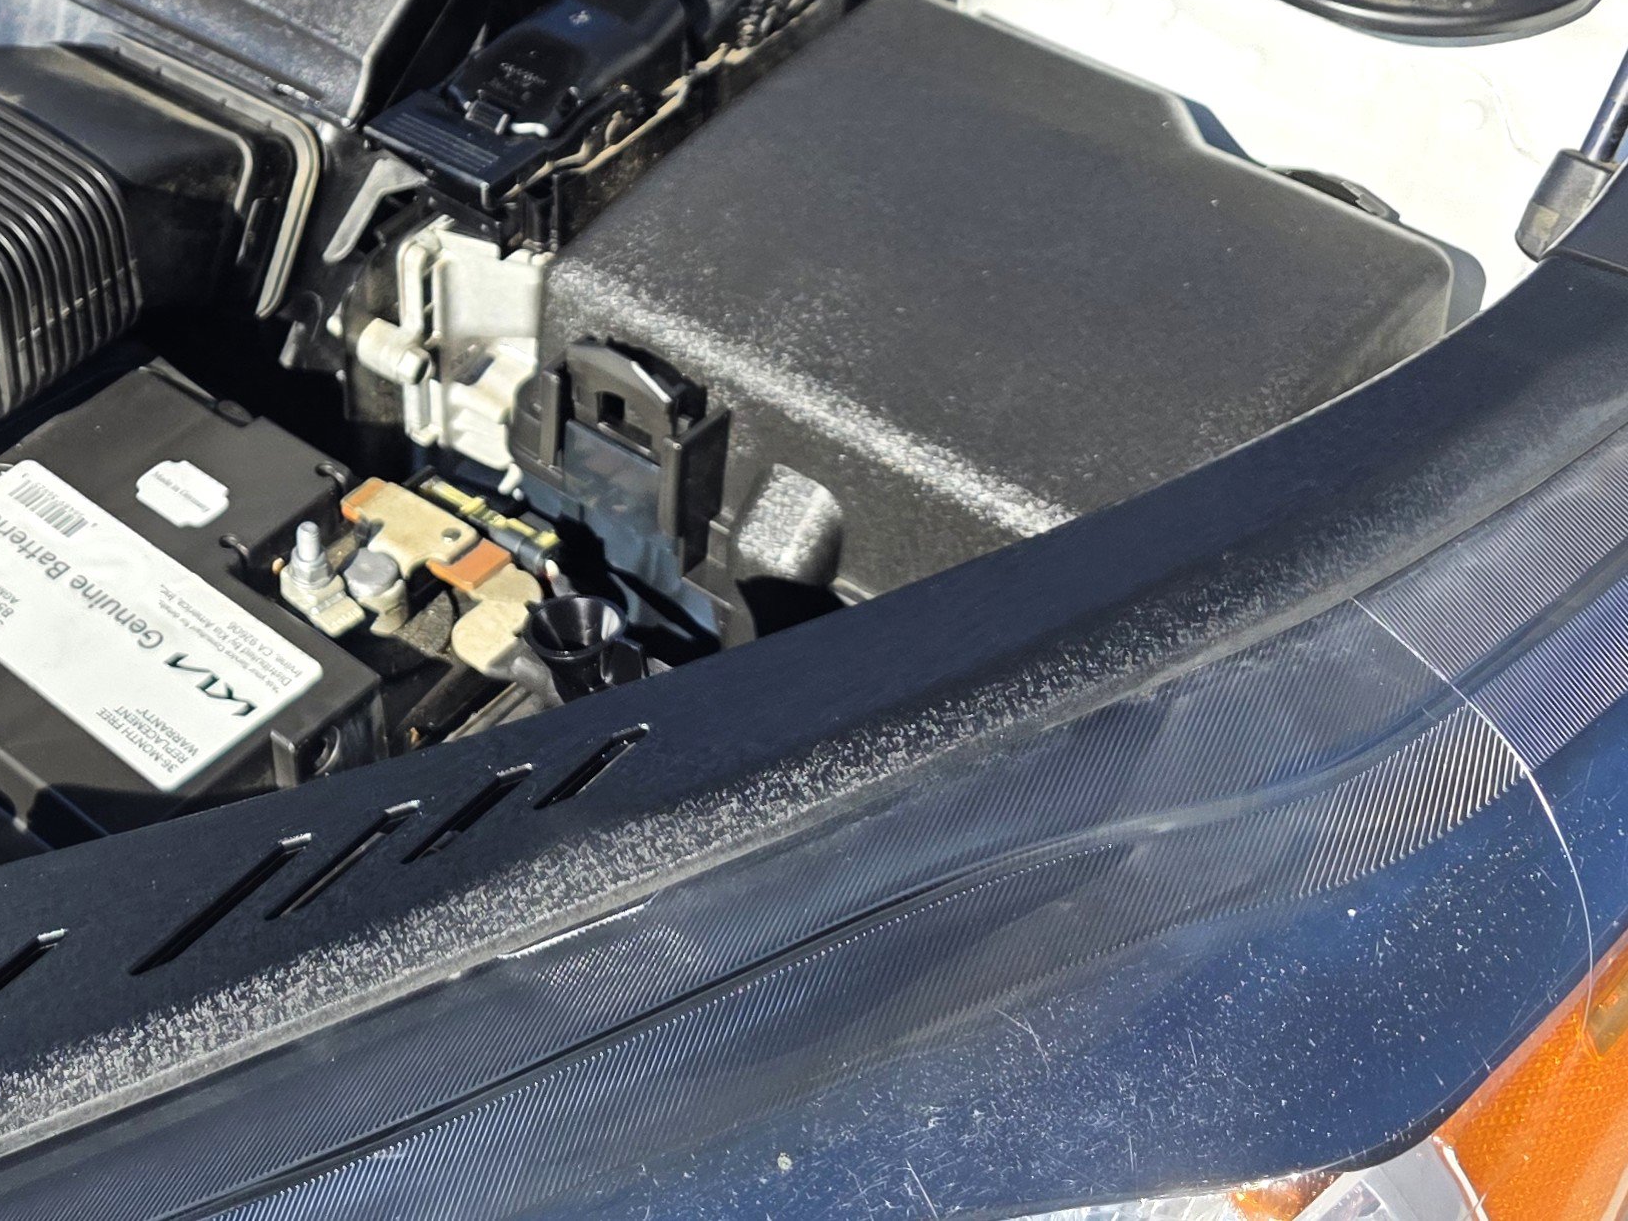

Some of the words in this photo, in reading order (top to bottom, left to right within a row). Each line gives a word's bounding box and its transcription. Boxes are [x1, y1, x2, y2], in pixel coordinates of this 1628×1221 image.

[69, 574, 163, 649] Genuine
[212, 626, 229, 640] Kia
[227, 637, 242, 650] by
[257, 643, 273, 656] CA
[274, 653, 302, 678] Irvine,
[239, 646, 292, 686] Distributed
[165, 654, 256, 716] KIA
[95, 707, 124, 730] FREE
[113, 706, 188, 763] REPLACEMENT
[120, 726, 178, 773] 36-MONTH
